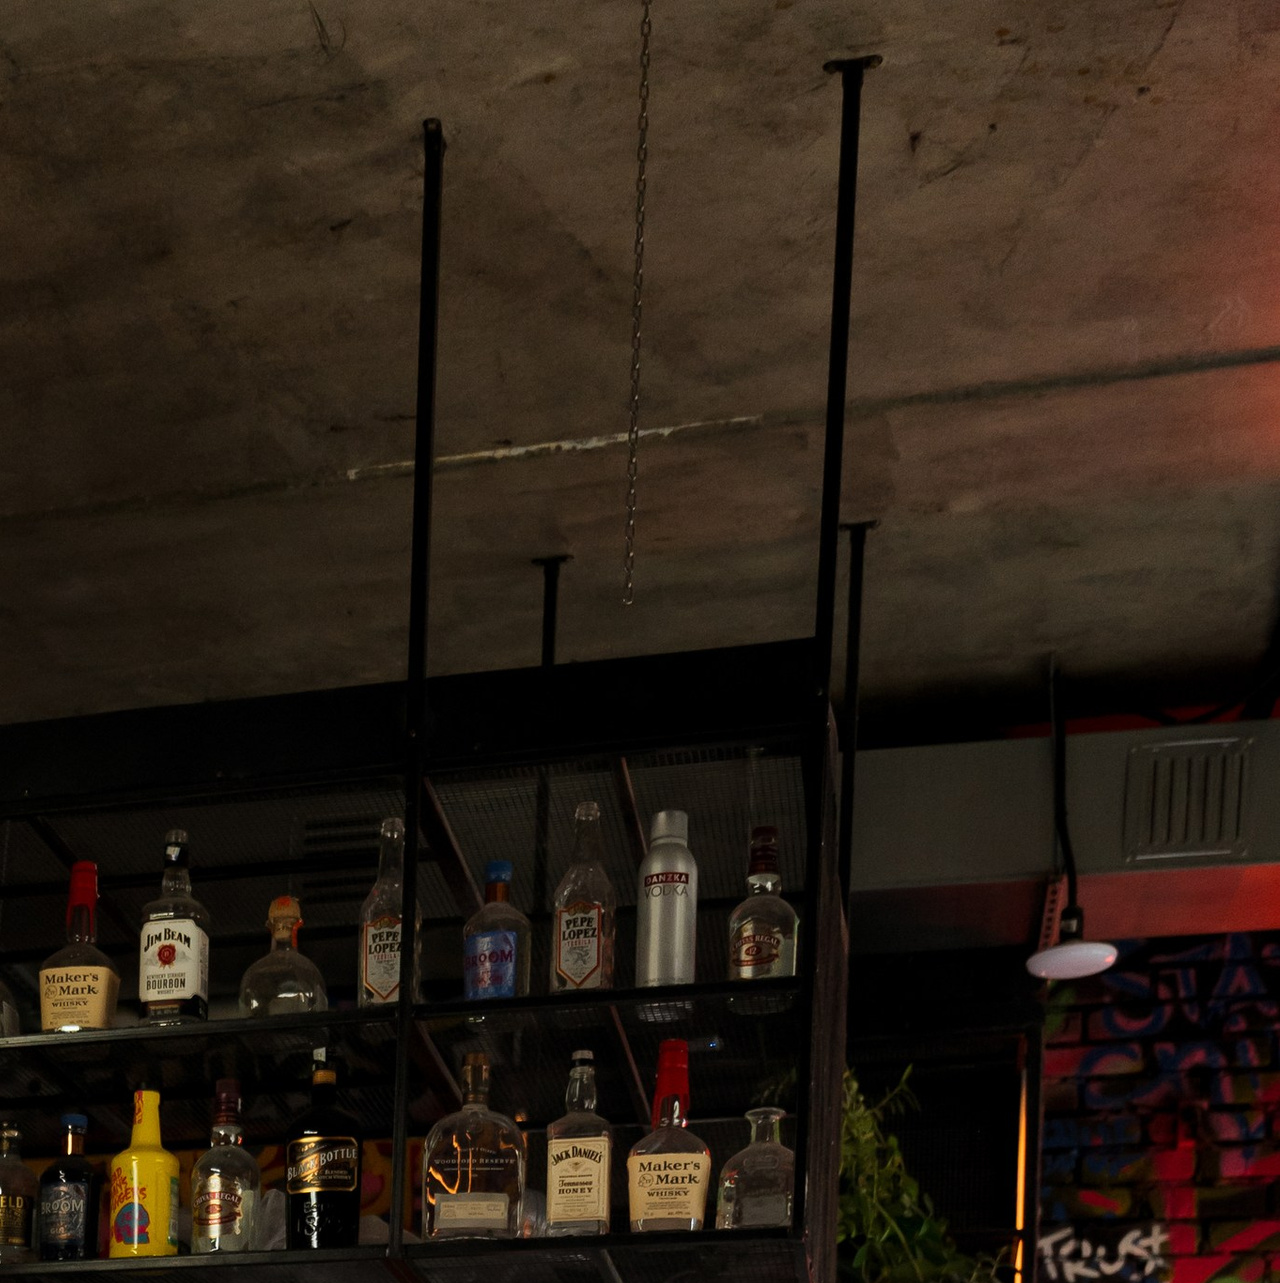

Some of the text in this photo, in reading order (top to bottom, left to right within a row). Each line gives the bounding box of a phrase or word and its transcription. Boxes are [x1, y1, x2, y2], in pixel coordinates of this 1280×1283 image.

[645, 872, 688, 885] DANZKA
[644, 884, 689, 900] VODKA
[565, 917, 594, 930] PEPE
[144, 927, 192, 953] JIM BEAM
[372, 931, 400, 943] PEPE
[561, 927, 597, 940] LOPEZ
[44, 972, 99, 985] Maker's
[146, 978, 186, 991] BOURBON
[51, 1000, 89, 1008] WHISKY
[319, 1147, 359, 1166] BOTTLE
[551, 1148, 571, 1166] JACK
[638, 1160, 701, 1173] Maker's
[558, 1187, 593, 1195] HONEY
[646, 1189, 690, 1197] WHISKY
